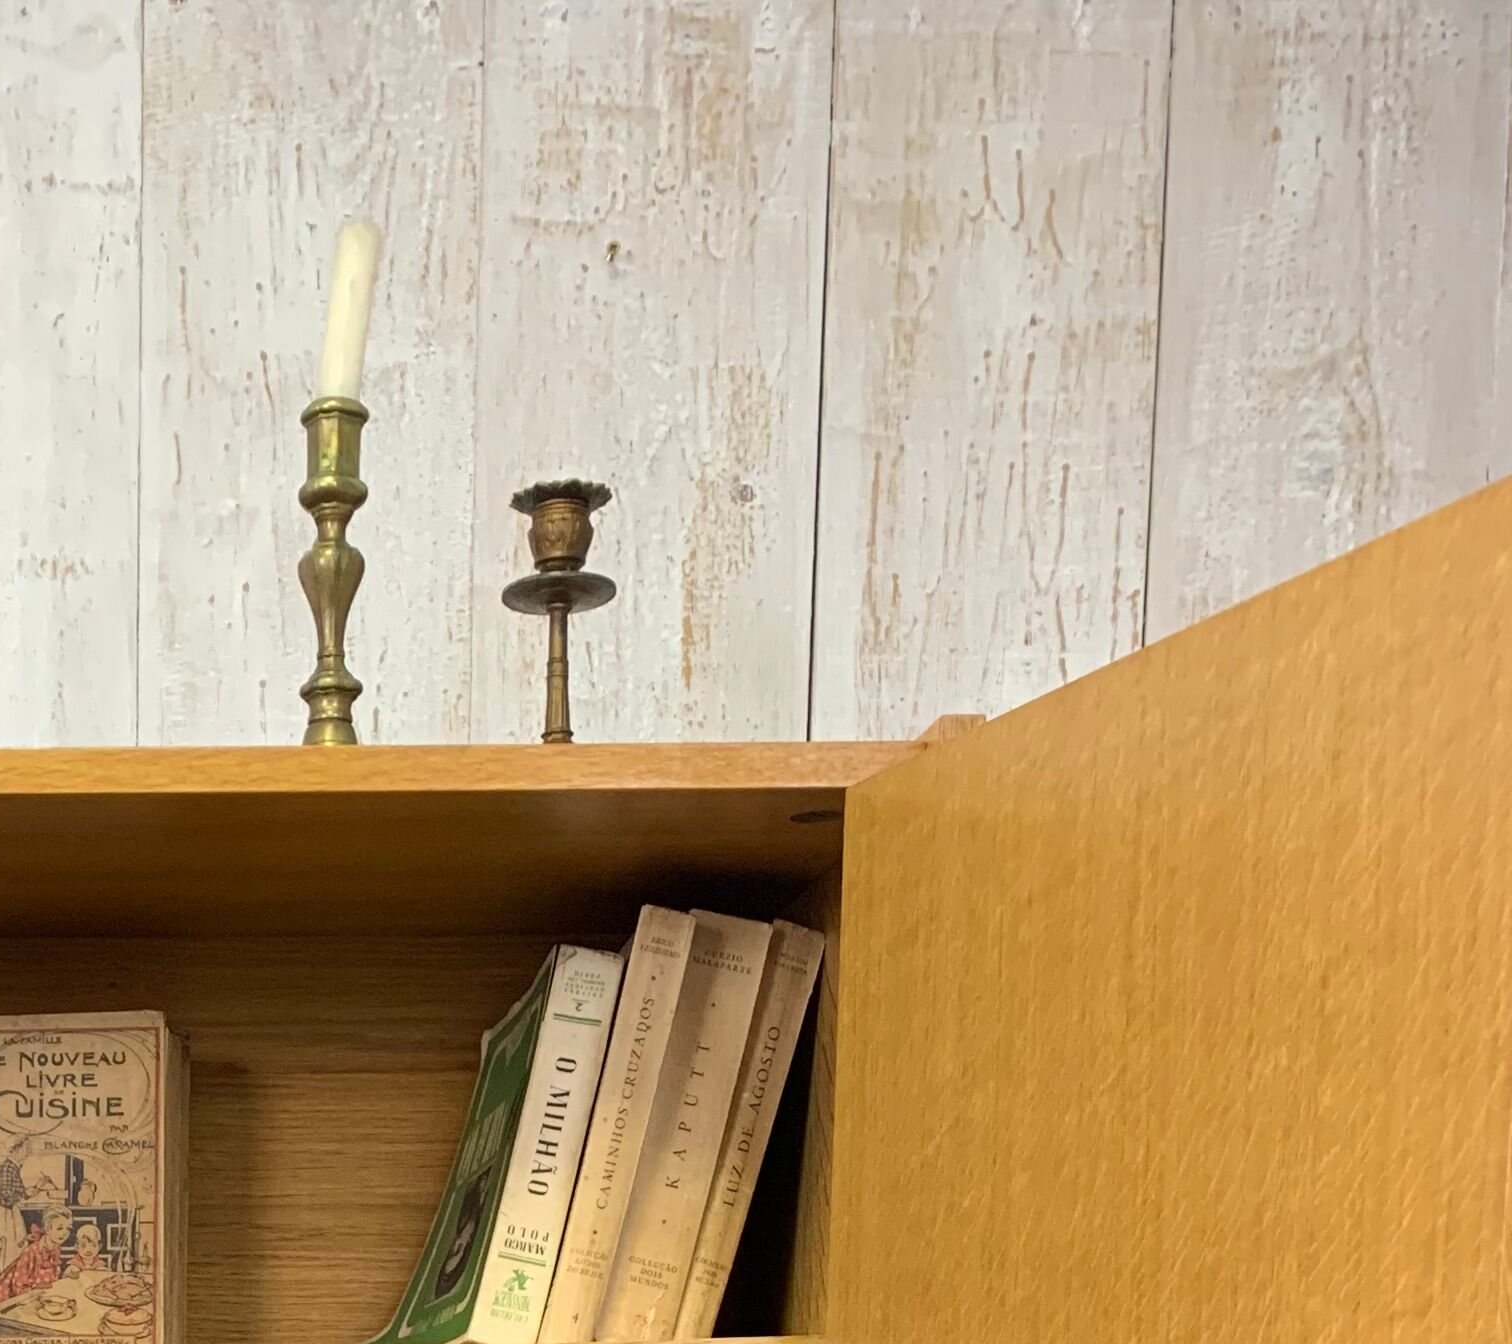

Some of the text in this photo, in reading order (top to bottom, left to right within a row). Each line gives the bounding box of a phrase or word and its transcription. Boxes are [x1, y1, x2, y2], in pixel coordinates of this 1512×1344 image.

[574, 1002, 583, 1012] 2
[19, 1051, 127, 1073] NOUVEAU
[25, 1070, 98, 1089] LIVRE
[596, 996, 655, 1210] CAMINHOS CRUZADOS
[665, 1040, 711, 1190] KAPUTT
[722, 1025, 782, 1208] LUZ DE AGOSTO
[109, 1124, 129, 1133] PAR
[527, 1056, 577, 1196] O MILHÃO
[44, 1137, 155, 1155] BLANCHE CARAMEL
[506, 1223, 550, 1243] POLO
[504, 1237, 548, 1256] MARCO
[572, 1312, 580, 1324] 4
